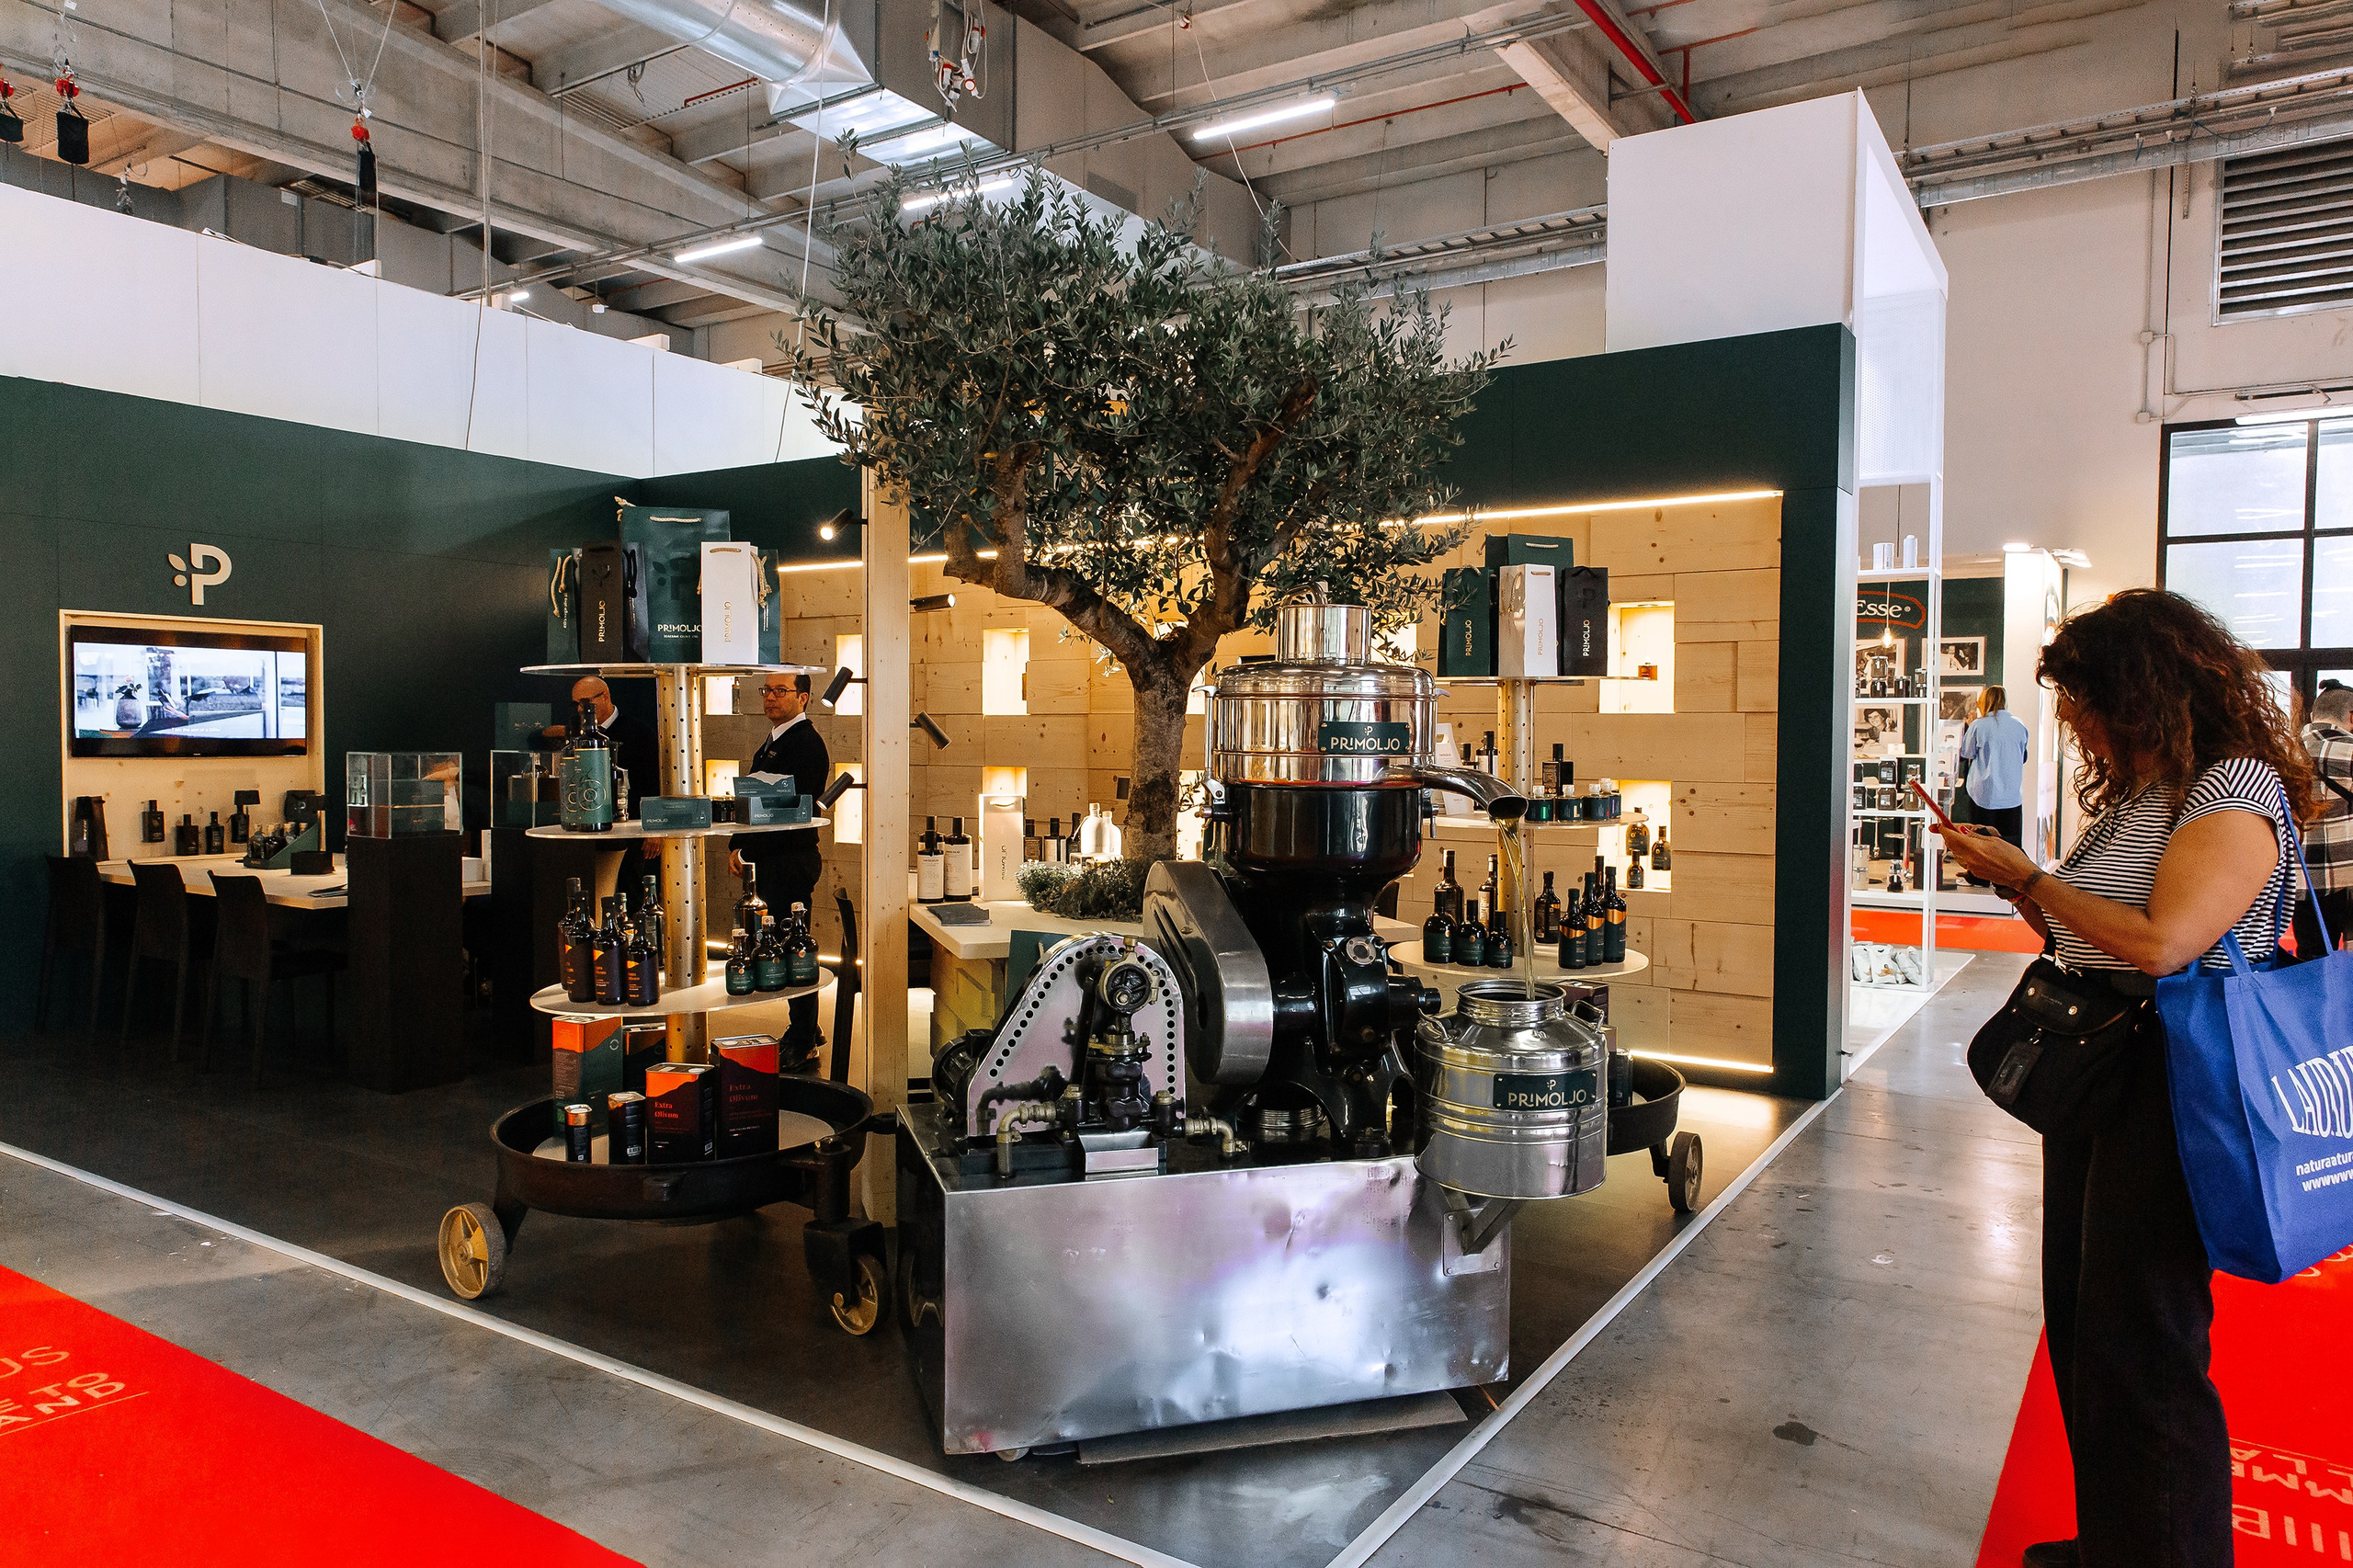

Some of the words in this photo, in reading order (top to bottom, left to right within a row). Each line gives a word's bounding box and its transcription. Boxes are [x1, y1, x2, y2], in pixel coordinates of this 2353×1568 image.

[1582, 619, 1590, 657] PRIMOLJO
[1330, 737, 1401, 751] PRIMOLJO
[1507, 1089, 1587, 1108] PRIMOLJO
